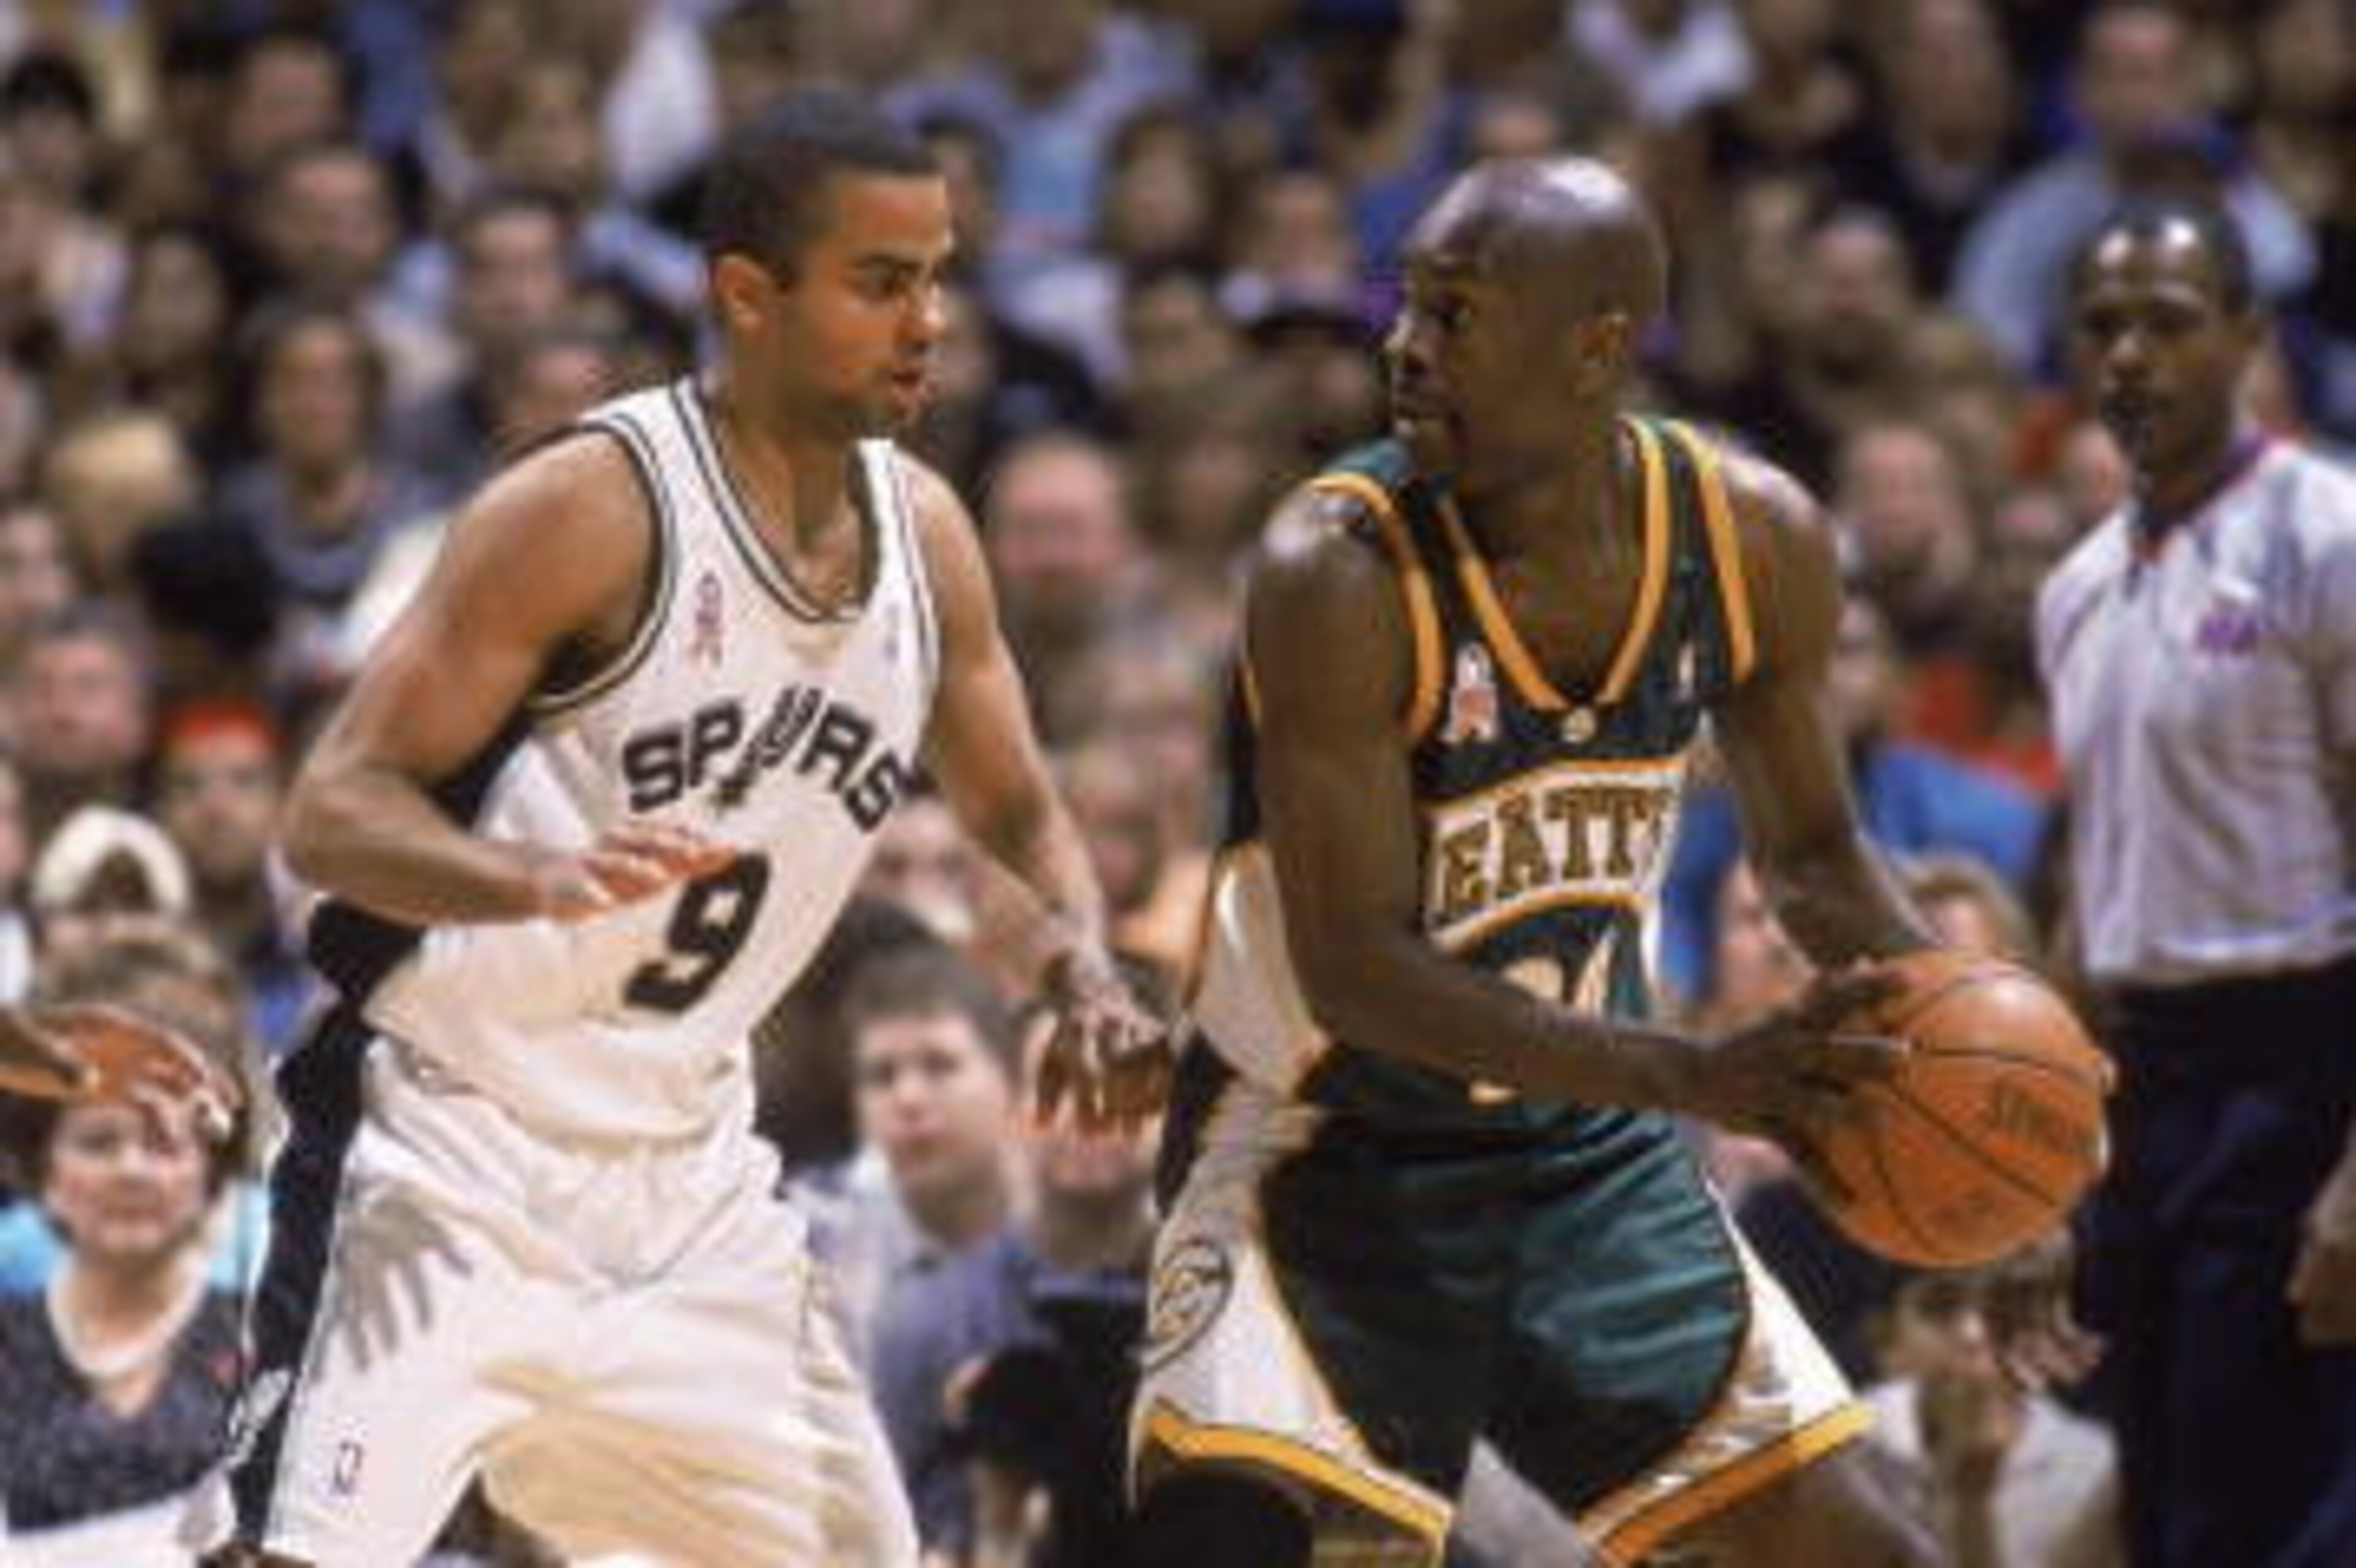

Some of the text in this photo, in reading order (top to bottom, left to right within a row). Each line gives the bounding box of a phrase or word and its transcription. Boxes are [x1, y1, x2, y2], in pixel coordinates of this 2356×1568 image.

[622, 687, 901, 834] SPURS
[1439, 784, 1674, 923] EATT
[621, 853, 771, 1020] 9
